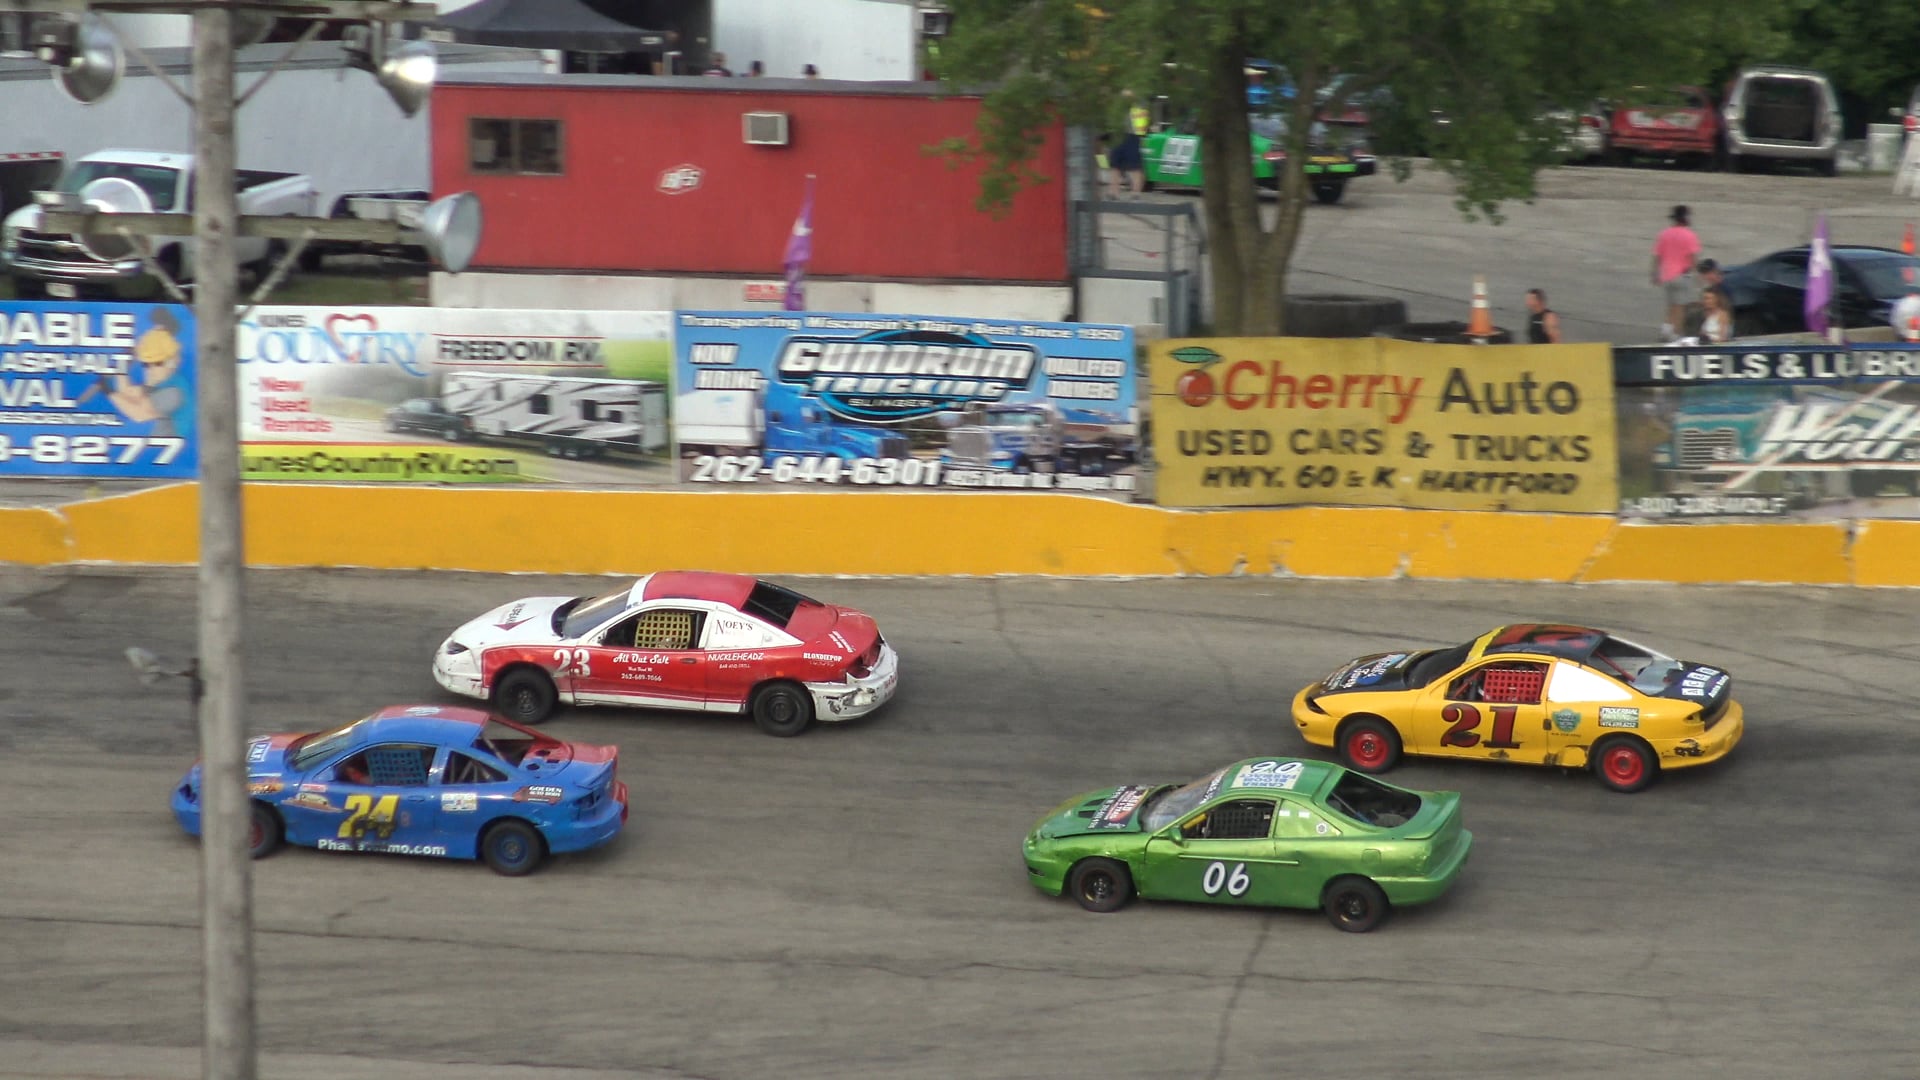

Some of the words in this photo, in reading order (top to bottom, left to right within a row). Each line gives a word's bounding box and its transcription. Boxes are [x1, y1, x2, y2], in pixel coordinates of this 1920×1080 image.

[680, 314, 800, 331] Transporting
[805, 316, 915, 331] Wisconsin's
[1019, 325, 1073, 338] Since
[1, 352, 134, 375] ASPHALT
[438, 339, 556, 361] FREEDOM
[780, 341, 1034, 379] GUNDRUM
[1650, 353, 1770, 380] FUELS
[1776, 353, 1806, 379] &
[812, 376, 1009, 396] TRUCKING
[1222, 359, 1425, 424] Cherry
[1437, 367, 1582, 415] Auto
[1177, 429, 1272, 456] USED
[1289, 428, 1385, 455] CARS
[1405, 431, 1434, 459] &
[1449, 433, 1592, 462] TRUCKS
[240, 451, 518, 479] unesCountryRV.com
[690, 454, 943, 486] 262-644-6301
[1295, 464, 1339, 489] 60
[1418, 470, 1580, 495] HARTFORD
[715, 619, 754, 635] NOEY'S
[553, 649, 591, 678] 23
[612, 652, 630, 663] All
[631, 653, 648, 664] Out
[649, 654, 670, 665] Salt
[708, 652, 765, 661] NUCKLEHEADZ
[1439, 702, 1523, 750] 21
[529, 785, 562, 793] GOLDEN
[337, 794, 401, 838] 24
[1203, 861, 1250, 897] 06
